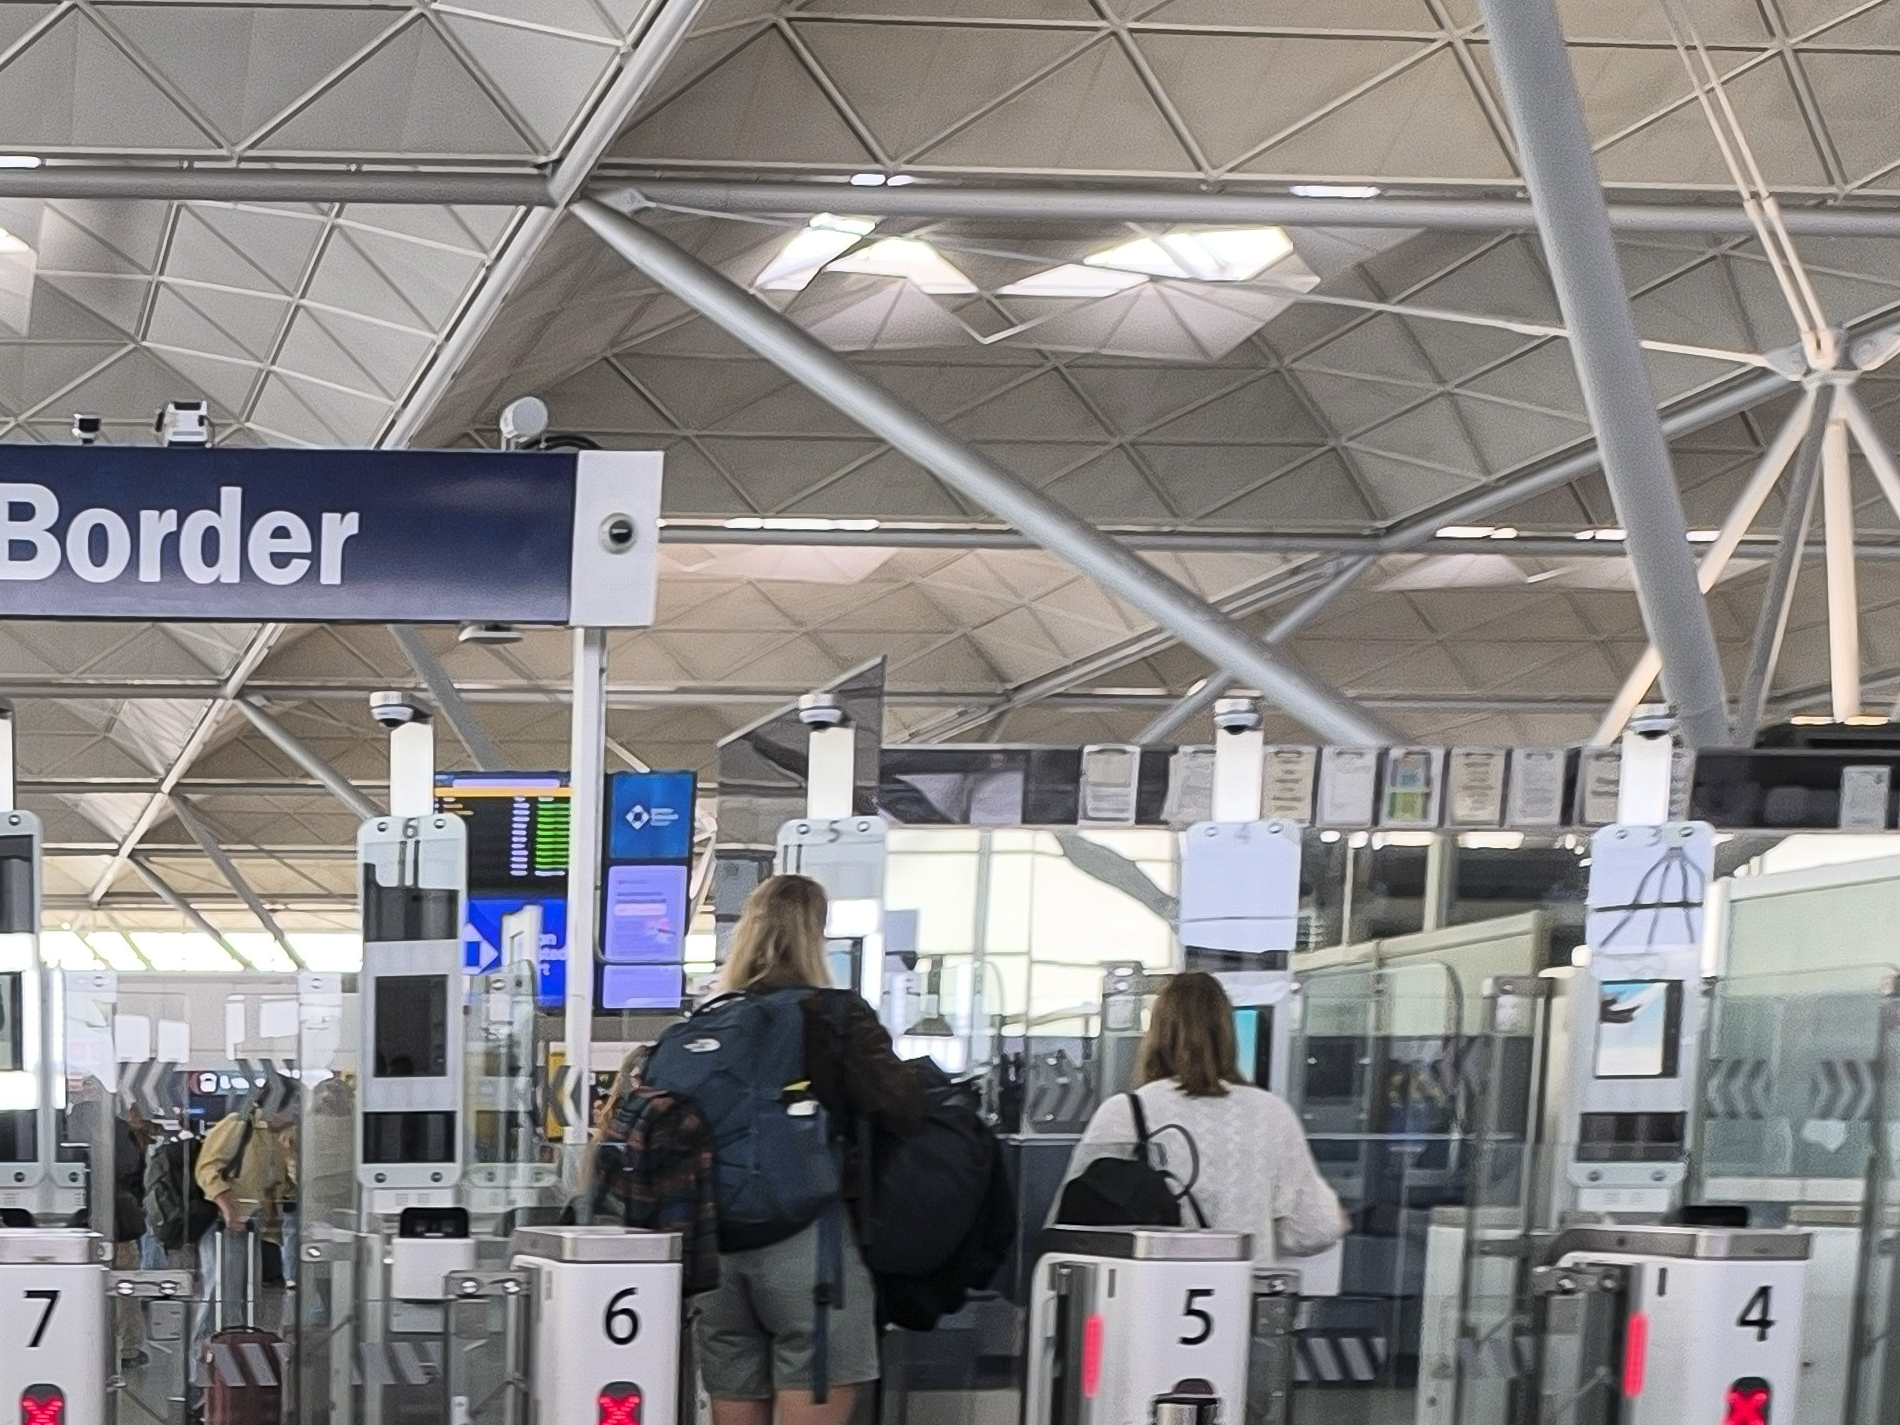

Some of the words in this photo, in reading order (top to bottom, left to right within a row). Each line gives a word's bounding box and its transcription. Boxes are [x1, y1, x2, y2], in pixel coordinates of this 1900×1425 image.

[402, 817, 419, 840] 6
[827, 819, 842, 844] 5
[23, 1288, 61, 1349] 7
[603, 1286, 640, 1347] 6
[1178, 1287, 1215, 1347] 5
[1736, 1284, 1776, 1343] 4
